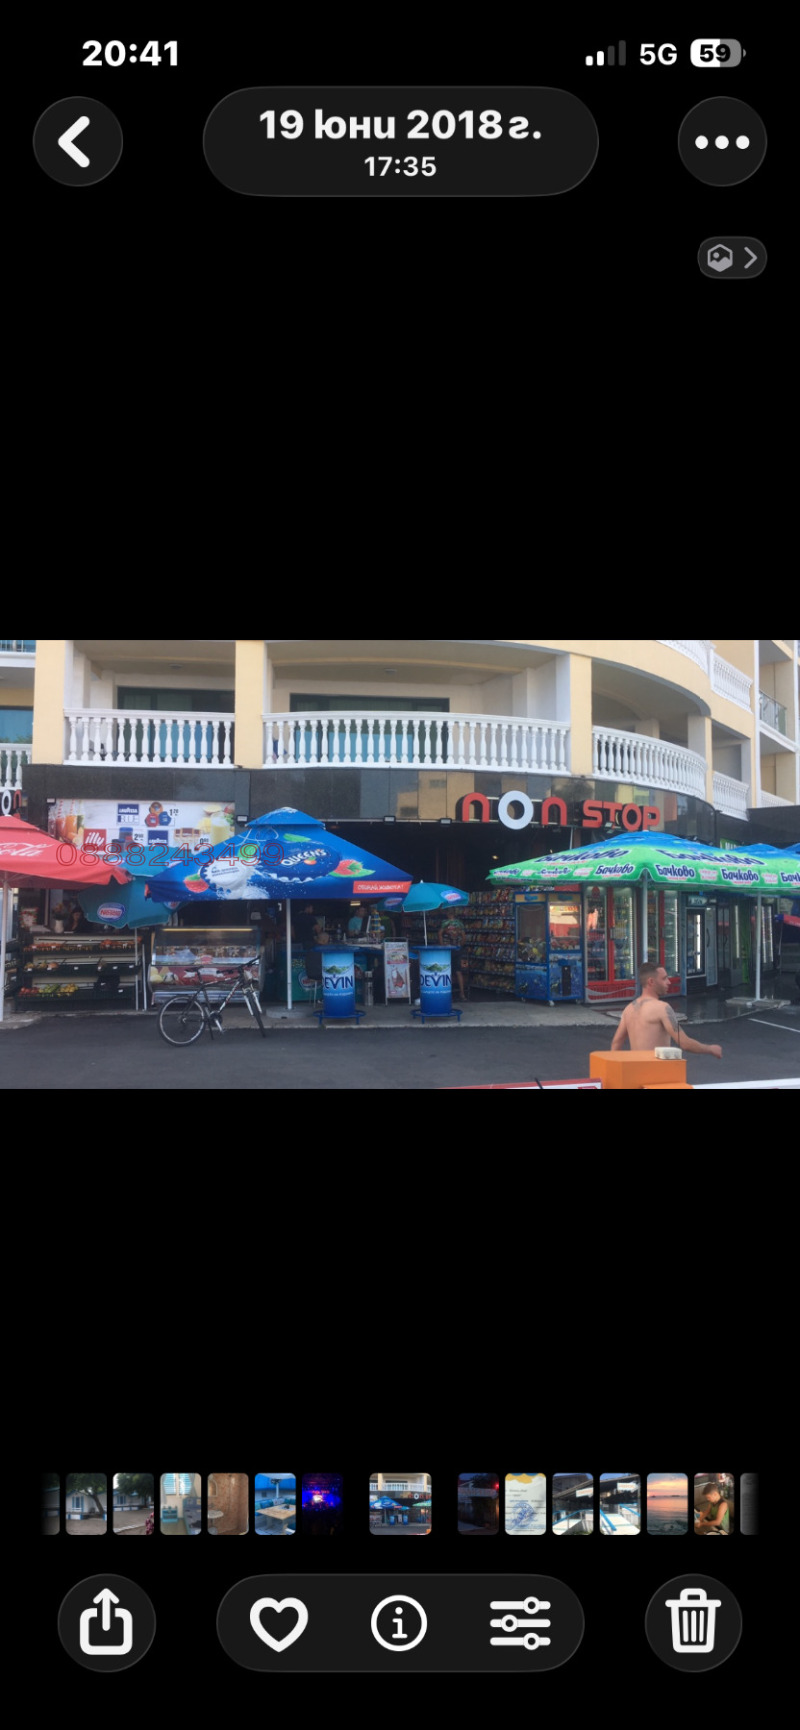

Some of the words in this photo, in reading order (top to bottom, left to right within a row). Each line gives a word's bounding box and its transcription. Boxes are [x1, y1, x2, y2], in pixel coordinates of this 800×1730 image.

[82, 40, 178, 66] 20:41
[639, 42, 678, 65] 5G
[699, 43, 732, 63] 59
[259, 109, 304, 138] 19
[364, 156, 437, 177] 17:35
[582, 800, 660, 831] STOP
[595, 864, 634, 876] Бачково
[655, 864, 695, 878] Бачково
[721, 868, 759, 881] Бачково
